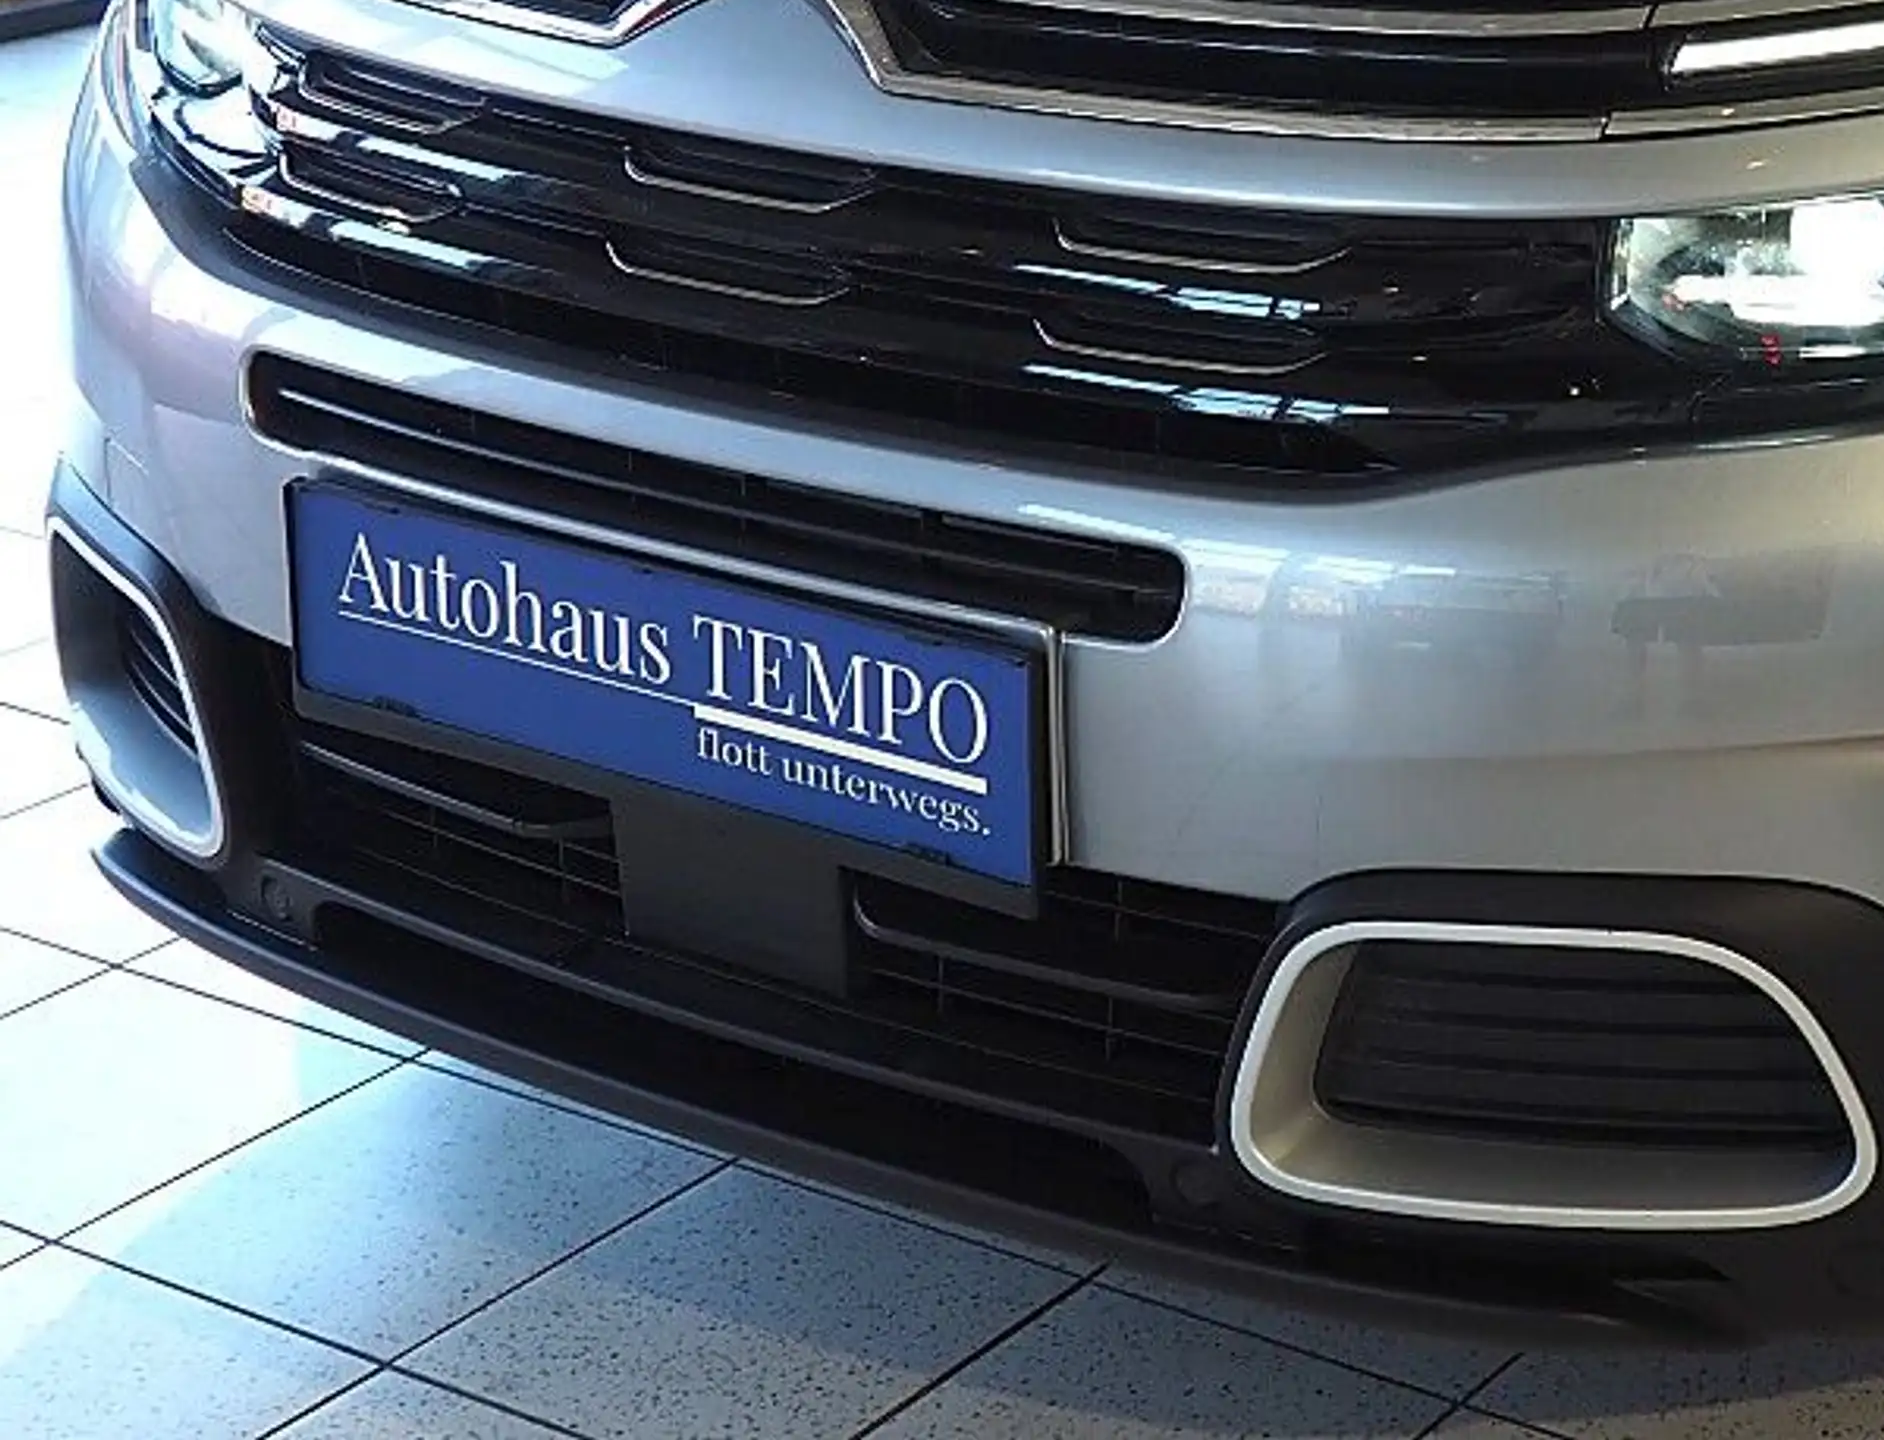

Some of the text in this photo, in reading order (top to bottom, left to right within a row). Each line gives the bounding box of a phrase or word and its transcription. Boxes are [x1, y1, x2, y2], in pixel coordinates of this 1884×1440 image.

[339, 531, 989, 764] Autohaus TEMPO
[697, 725, 991, 836] flott unterwegs.
